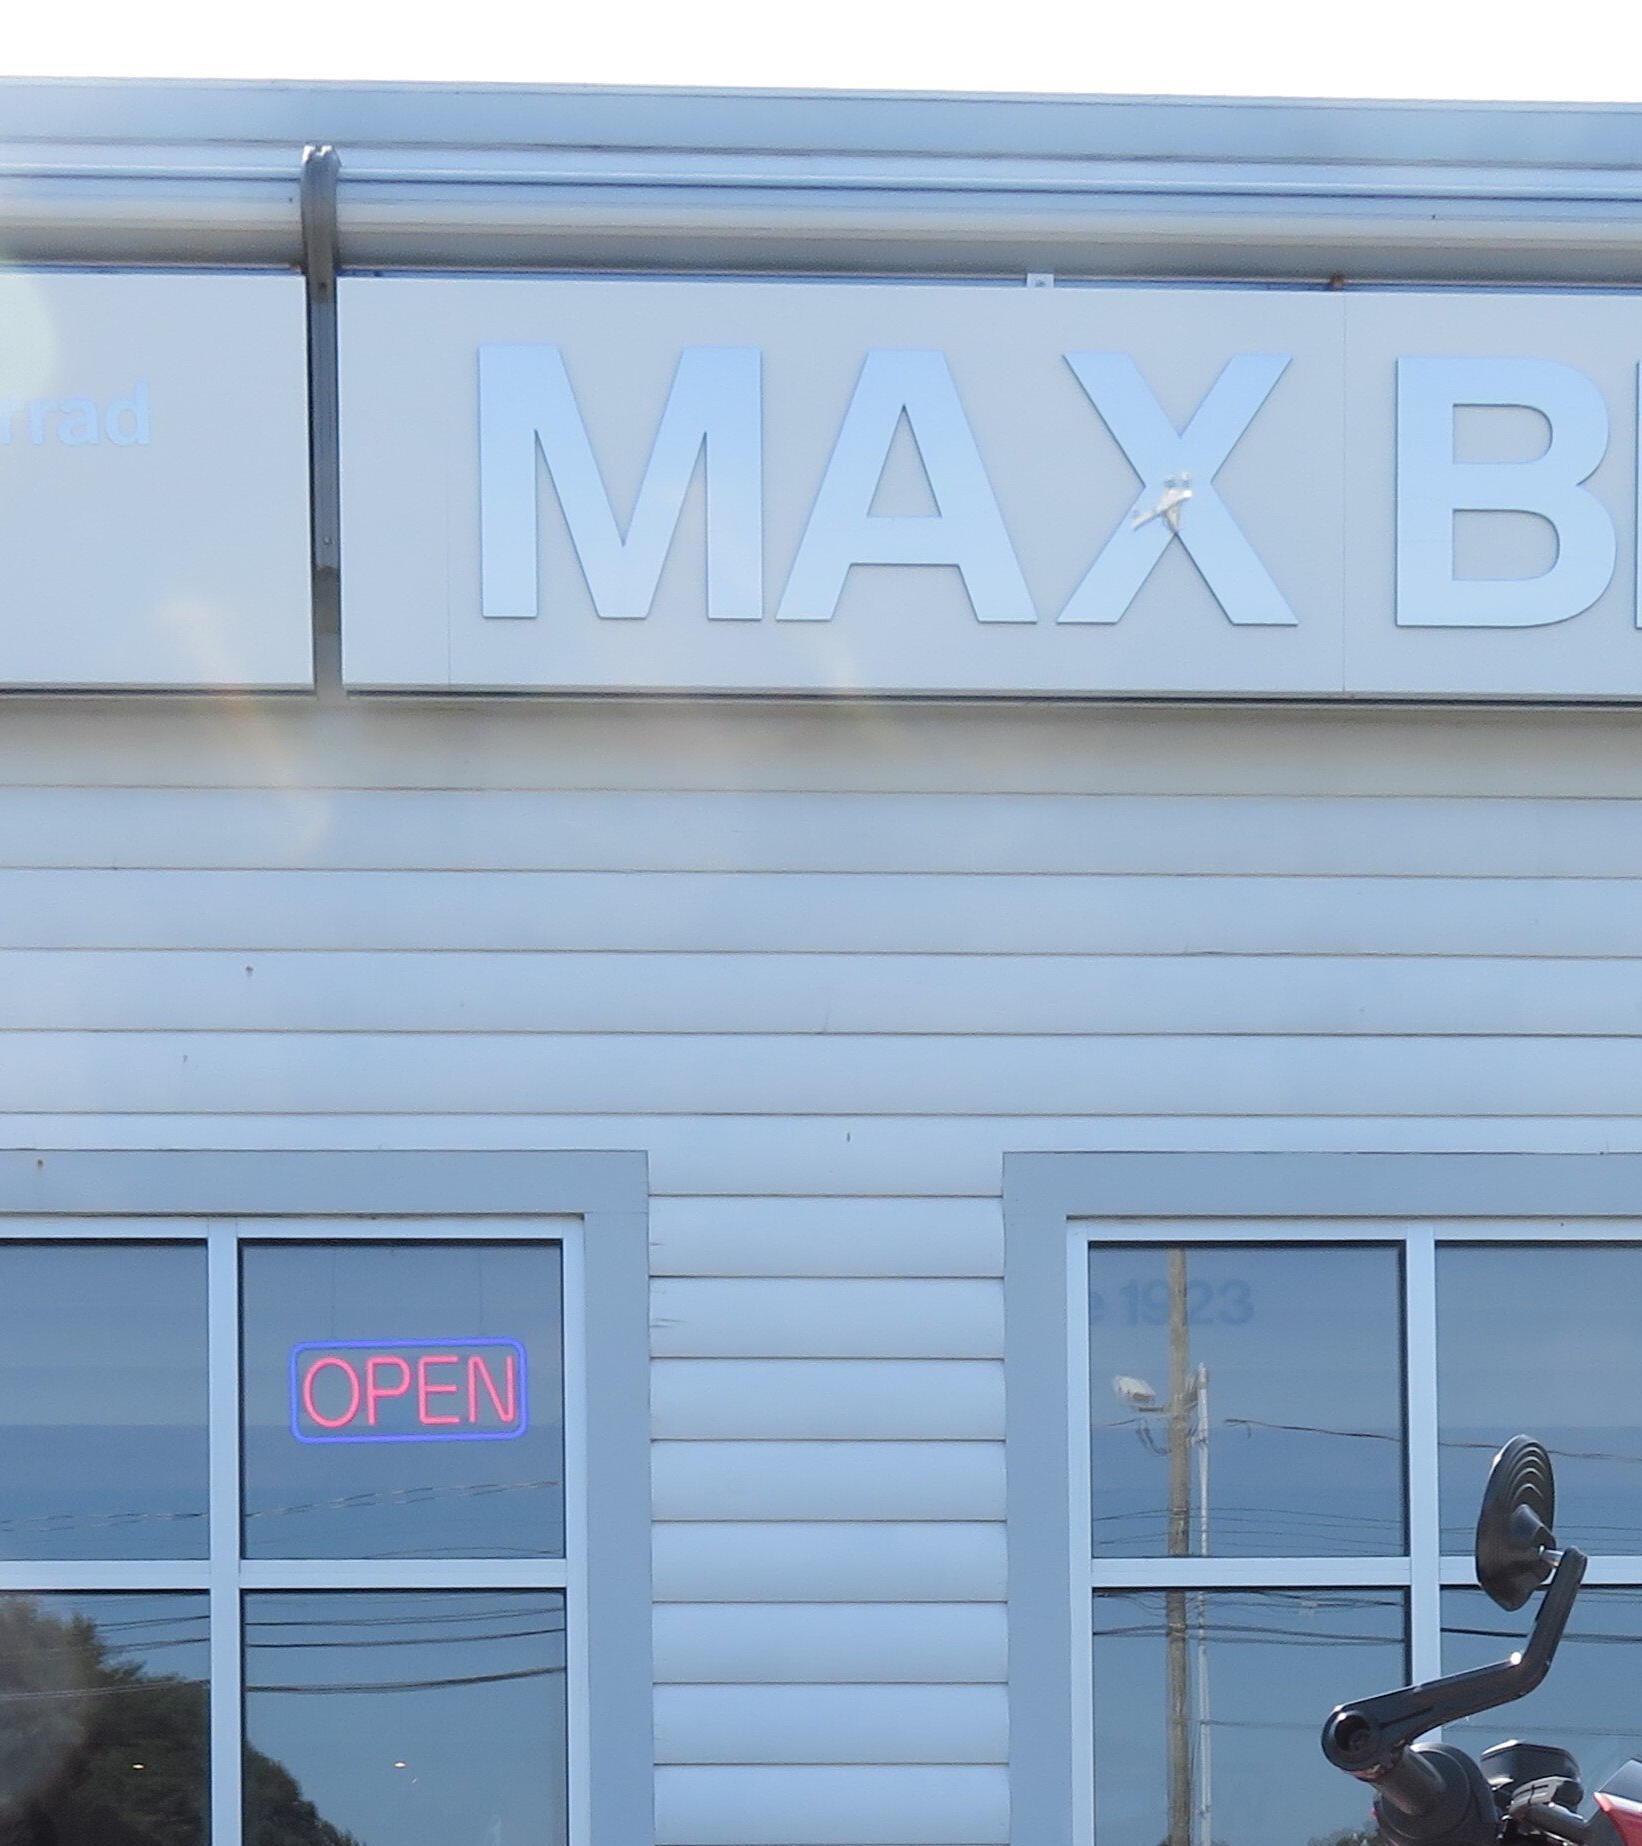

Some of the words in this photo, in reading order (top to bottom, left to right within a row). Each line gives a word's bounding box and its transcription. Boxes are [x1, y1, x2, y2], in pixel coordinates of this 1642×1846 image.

[476, 343, 1300, 627] MAX
[1118, 1278, 1255, 1327] 1923
[302, 1355, 516, 1428] OPEN
